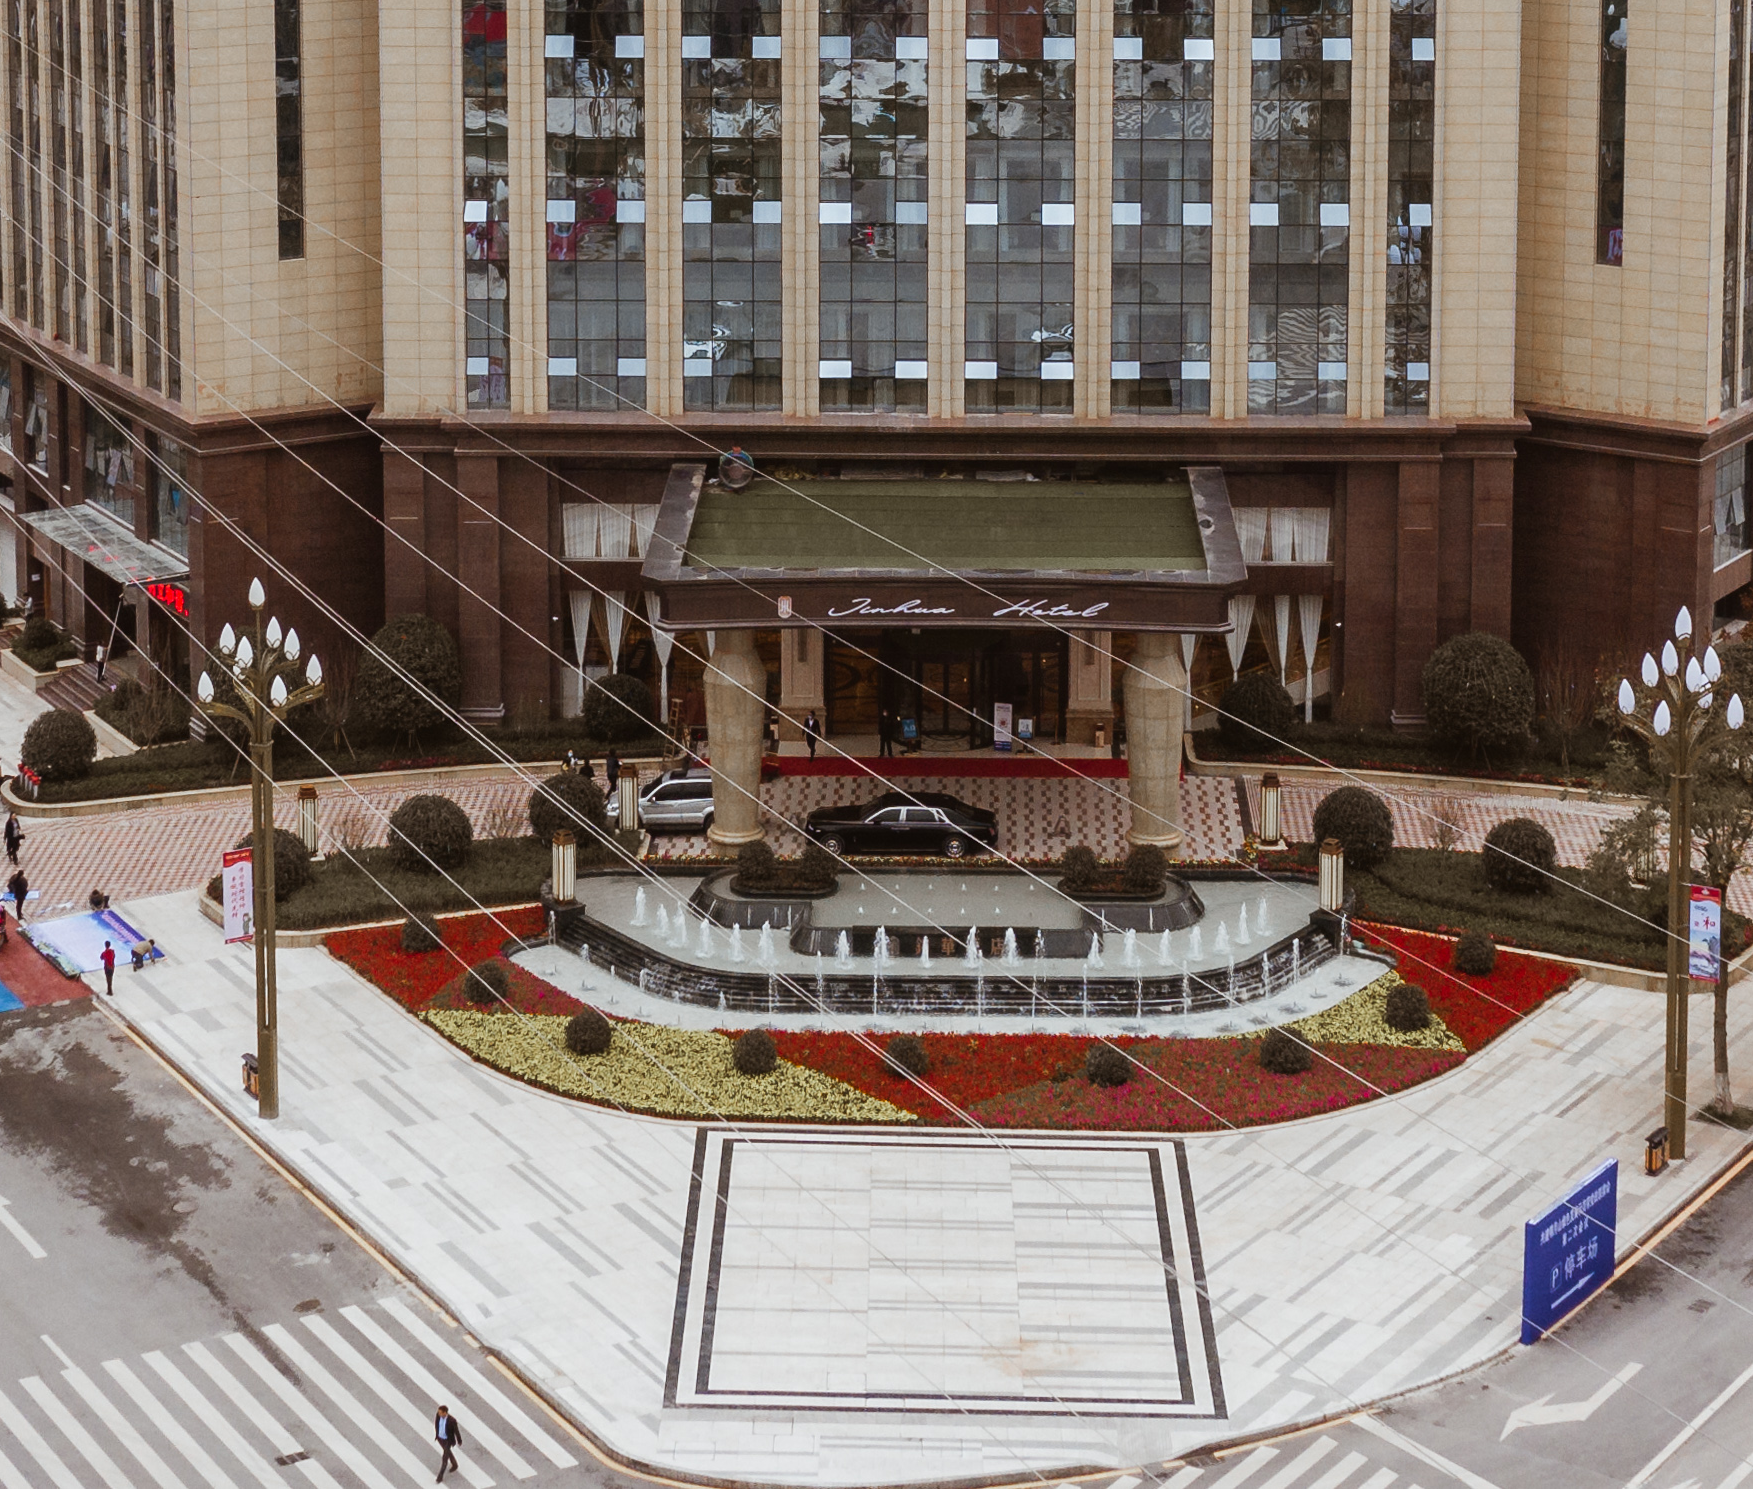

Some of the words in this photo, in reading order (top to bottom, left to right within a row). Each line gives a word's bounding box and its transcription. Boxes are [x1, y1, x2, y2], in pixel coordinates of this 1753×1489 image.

[827, 597, 956, 618] Jinhua
[992, 597, 1110, 618] Hotel
[1564, 1235, 1599, 1281] 停车场
